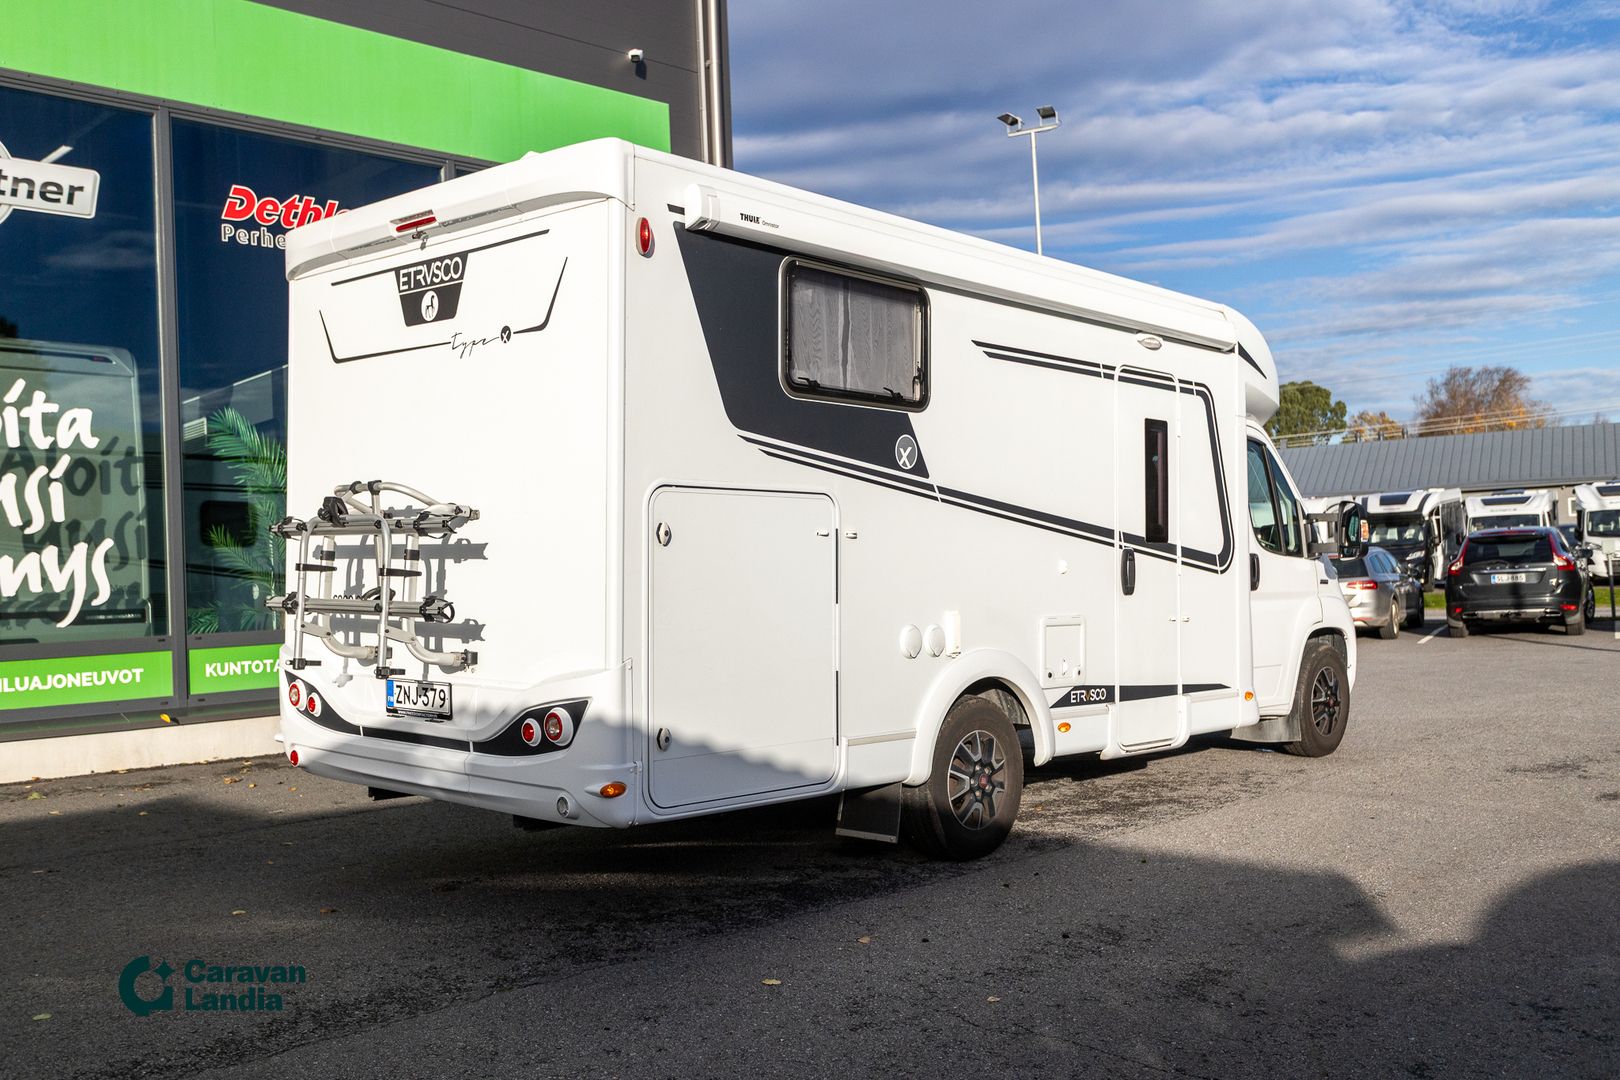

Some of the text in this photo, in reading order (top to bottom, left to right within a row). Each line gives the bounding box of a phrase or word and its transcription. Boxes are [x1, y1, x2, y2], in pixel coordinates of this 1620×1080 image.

[221, 184, 350, 229] Dethl
[740, 212, 760, 224] THULE
[221, 223, 286, 250] Perhe
[395, 684, 446, 709] ZNJ-379
